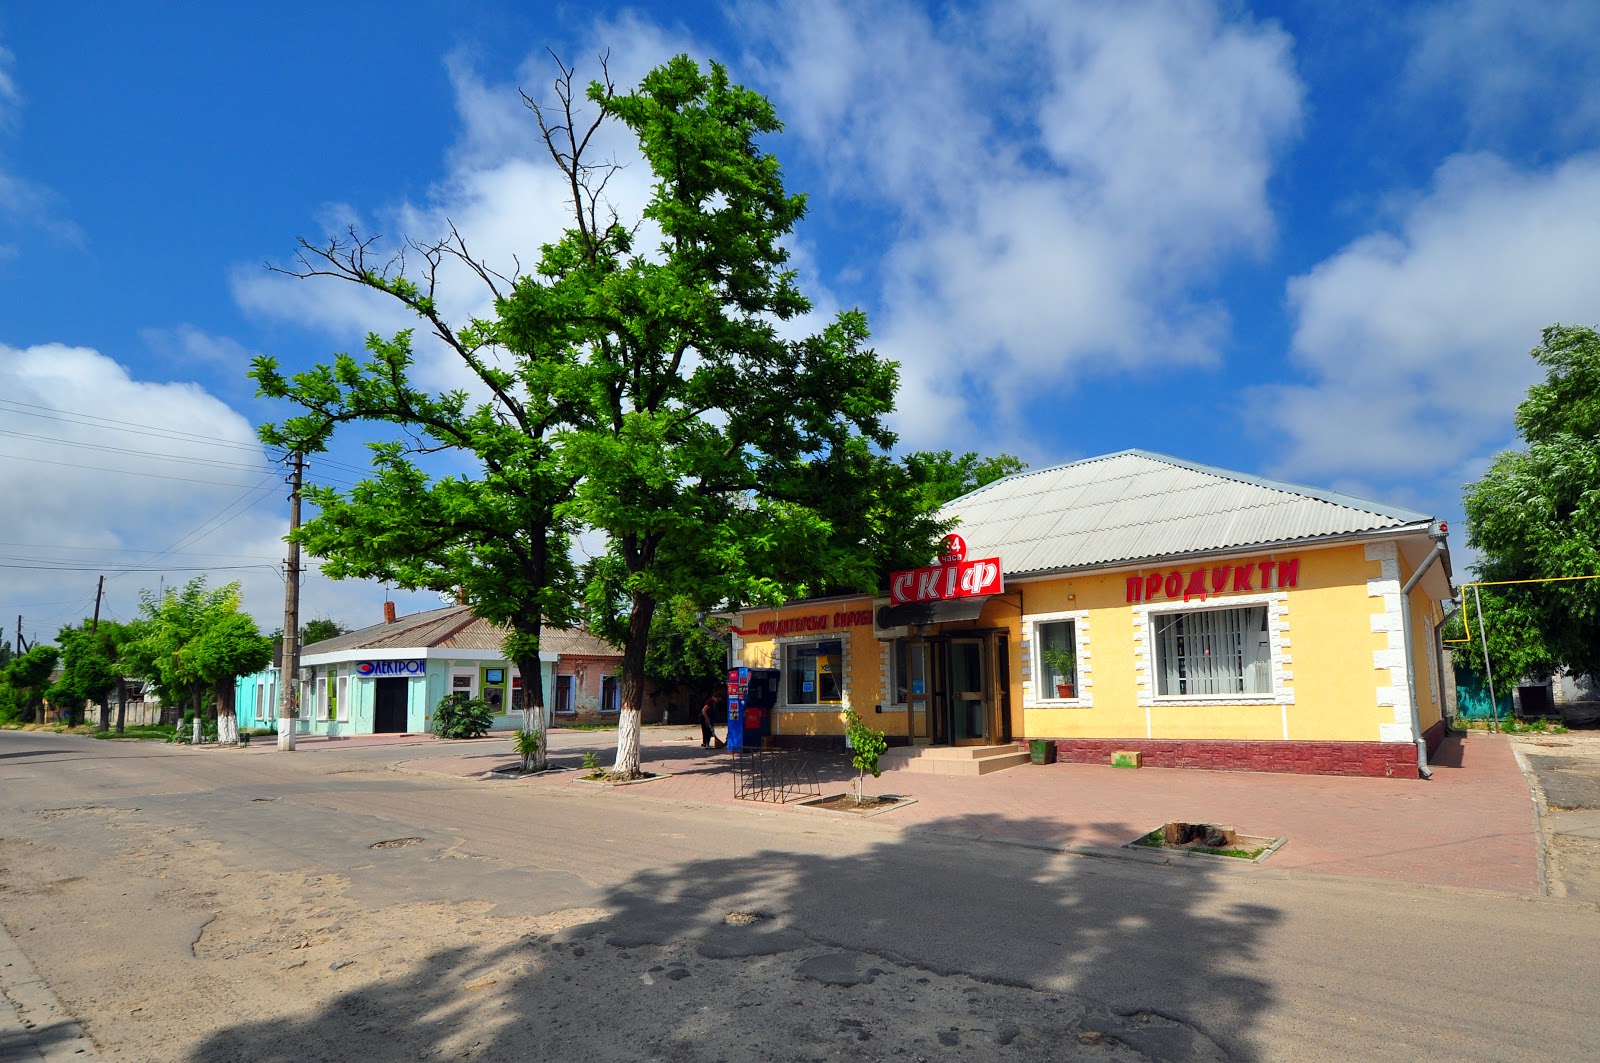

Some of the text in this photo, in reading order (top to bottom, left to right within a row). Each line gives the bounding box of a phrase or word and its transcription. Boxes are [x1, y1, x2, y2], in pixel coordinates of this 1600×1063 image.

[941, 553, 962, 563] часа
[893, 562, 998, 602] СКІФ
[1126, 559, 1298, 603] ПРОДУКТИ
